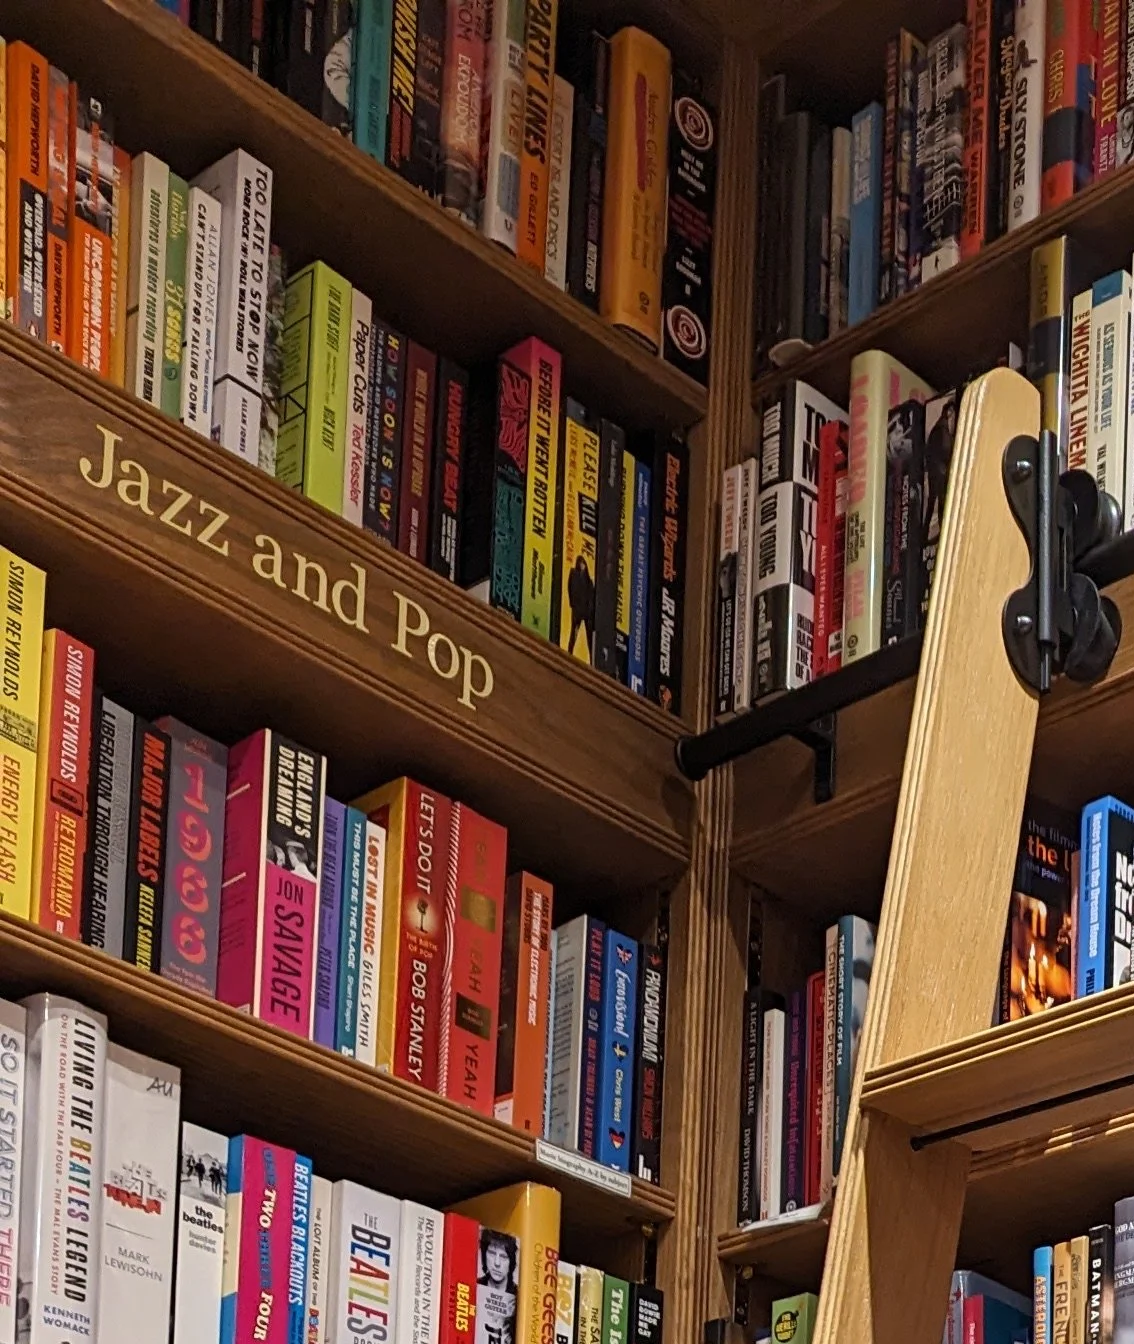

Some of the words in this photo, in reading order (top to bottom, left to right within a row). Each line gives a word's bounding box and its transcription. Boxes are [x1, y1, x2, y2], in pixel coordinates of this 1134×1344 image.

[257, 168, 270, 210] TOO
[254, 213, 267, 250] LATE
[252, 258, 264, 285] TO
[249, 289, 263, 334] STOP
[246, 340, 261, 385] NOW
[354, 321, 370, 369] Paper
[352, 372, 368, 415] Cuts
[352, 423, 364, 450] Ted
[349, 452, 362, 506] Kessler
[78, 423, 230, 558] Jazz
[251, 529, 370, 634] and
[390, 590, 496, 711] Pop
[65, 645, 84, 697] SIMON
[59, 702, 80, 783] REYNOLDS
[275, 745, 295, 831] DREAMING
[55, 813, 76, 921] RETROMANIA
[418, 839, 433, 874] DO
[416, 877, 432, 895] IT
[411, 959, 427, 1001] BOB
[71, 1017, 95, 1094] LIVING
[408, 1001, 426, 1082] STANLEY
[69, 1095, 93, 1135] THE
[67, 1137, 92, 1223] BEATLES
[64, 1227, 89, 1303] LEGEND
[346, 1223, 391, 1342] BEATLES
[42, 1315, 90, 1337] WOMACK
[43, 1304, 91, 1326] KENNETH
[610, 1289, 624, 1324] The
